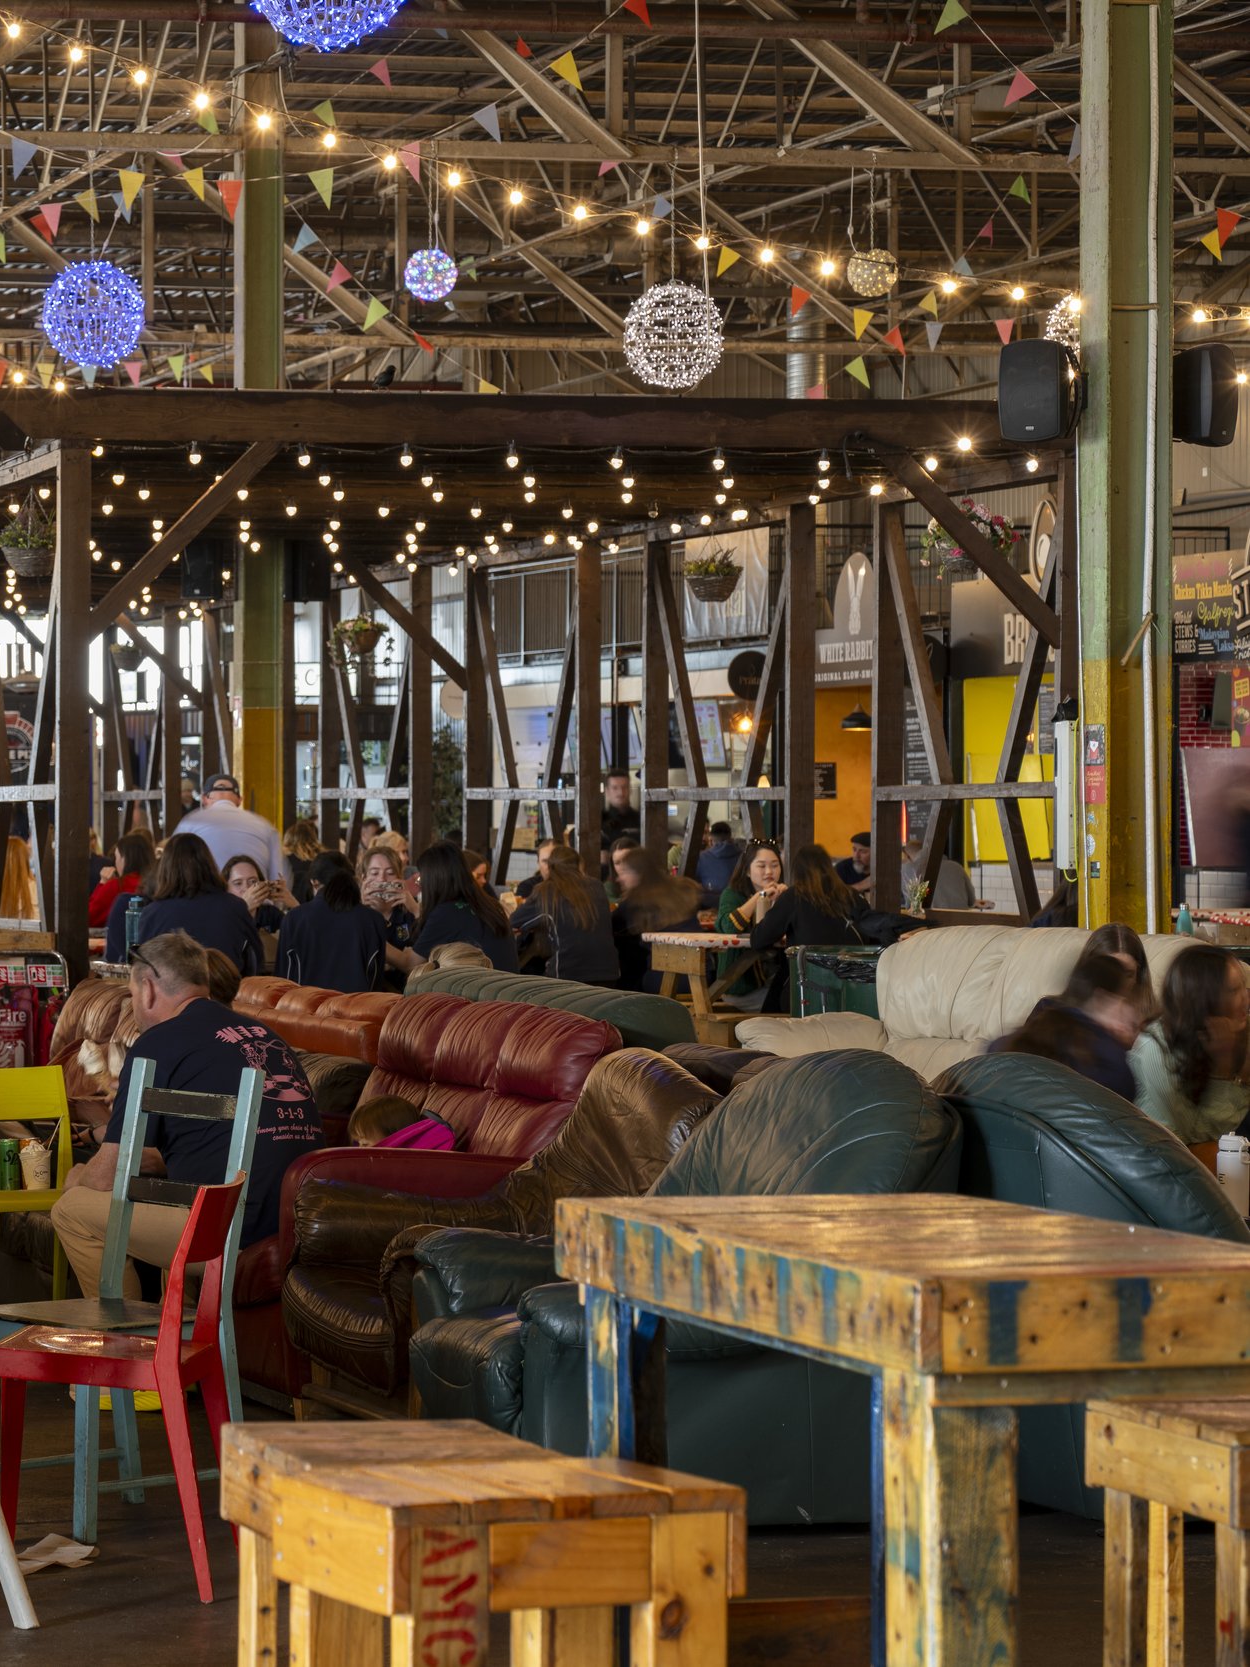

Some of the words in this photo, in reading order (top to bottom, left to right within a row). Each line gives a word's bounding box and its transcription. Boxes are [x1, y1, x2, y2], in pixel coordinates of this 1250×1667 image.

[1175, 584, 1196, 600] Chicken
[1196, 582, 1213, 599] Tikka
[1213, 580, 1232, 597] Masala
[1175, 625, 1193, 638] STEWS
[819, 642, 844, 664] WHITE
[276, 1107, 304, 1119] 3-1-3
